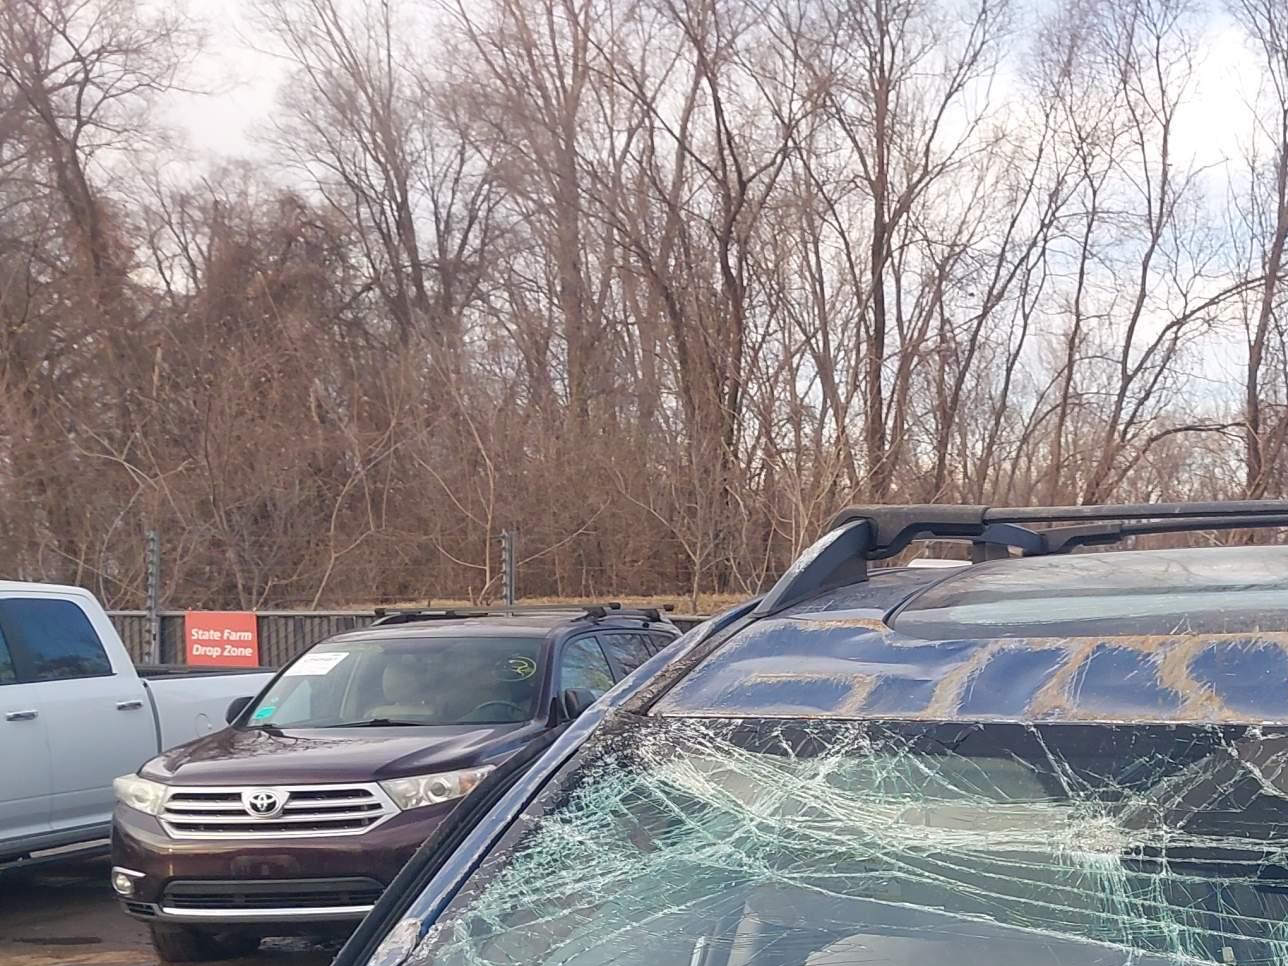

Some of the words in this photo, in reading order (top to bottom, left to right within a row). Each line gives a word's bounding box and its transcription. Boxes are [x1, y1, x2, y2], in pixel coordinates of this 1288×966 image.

[191, 628, 221, 640] State
[223, 629, 252, 641] Farm
[192, 644, 221, 658] Drop
[223, 645, 253, 657] Zone
